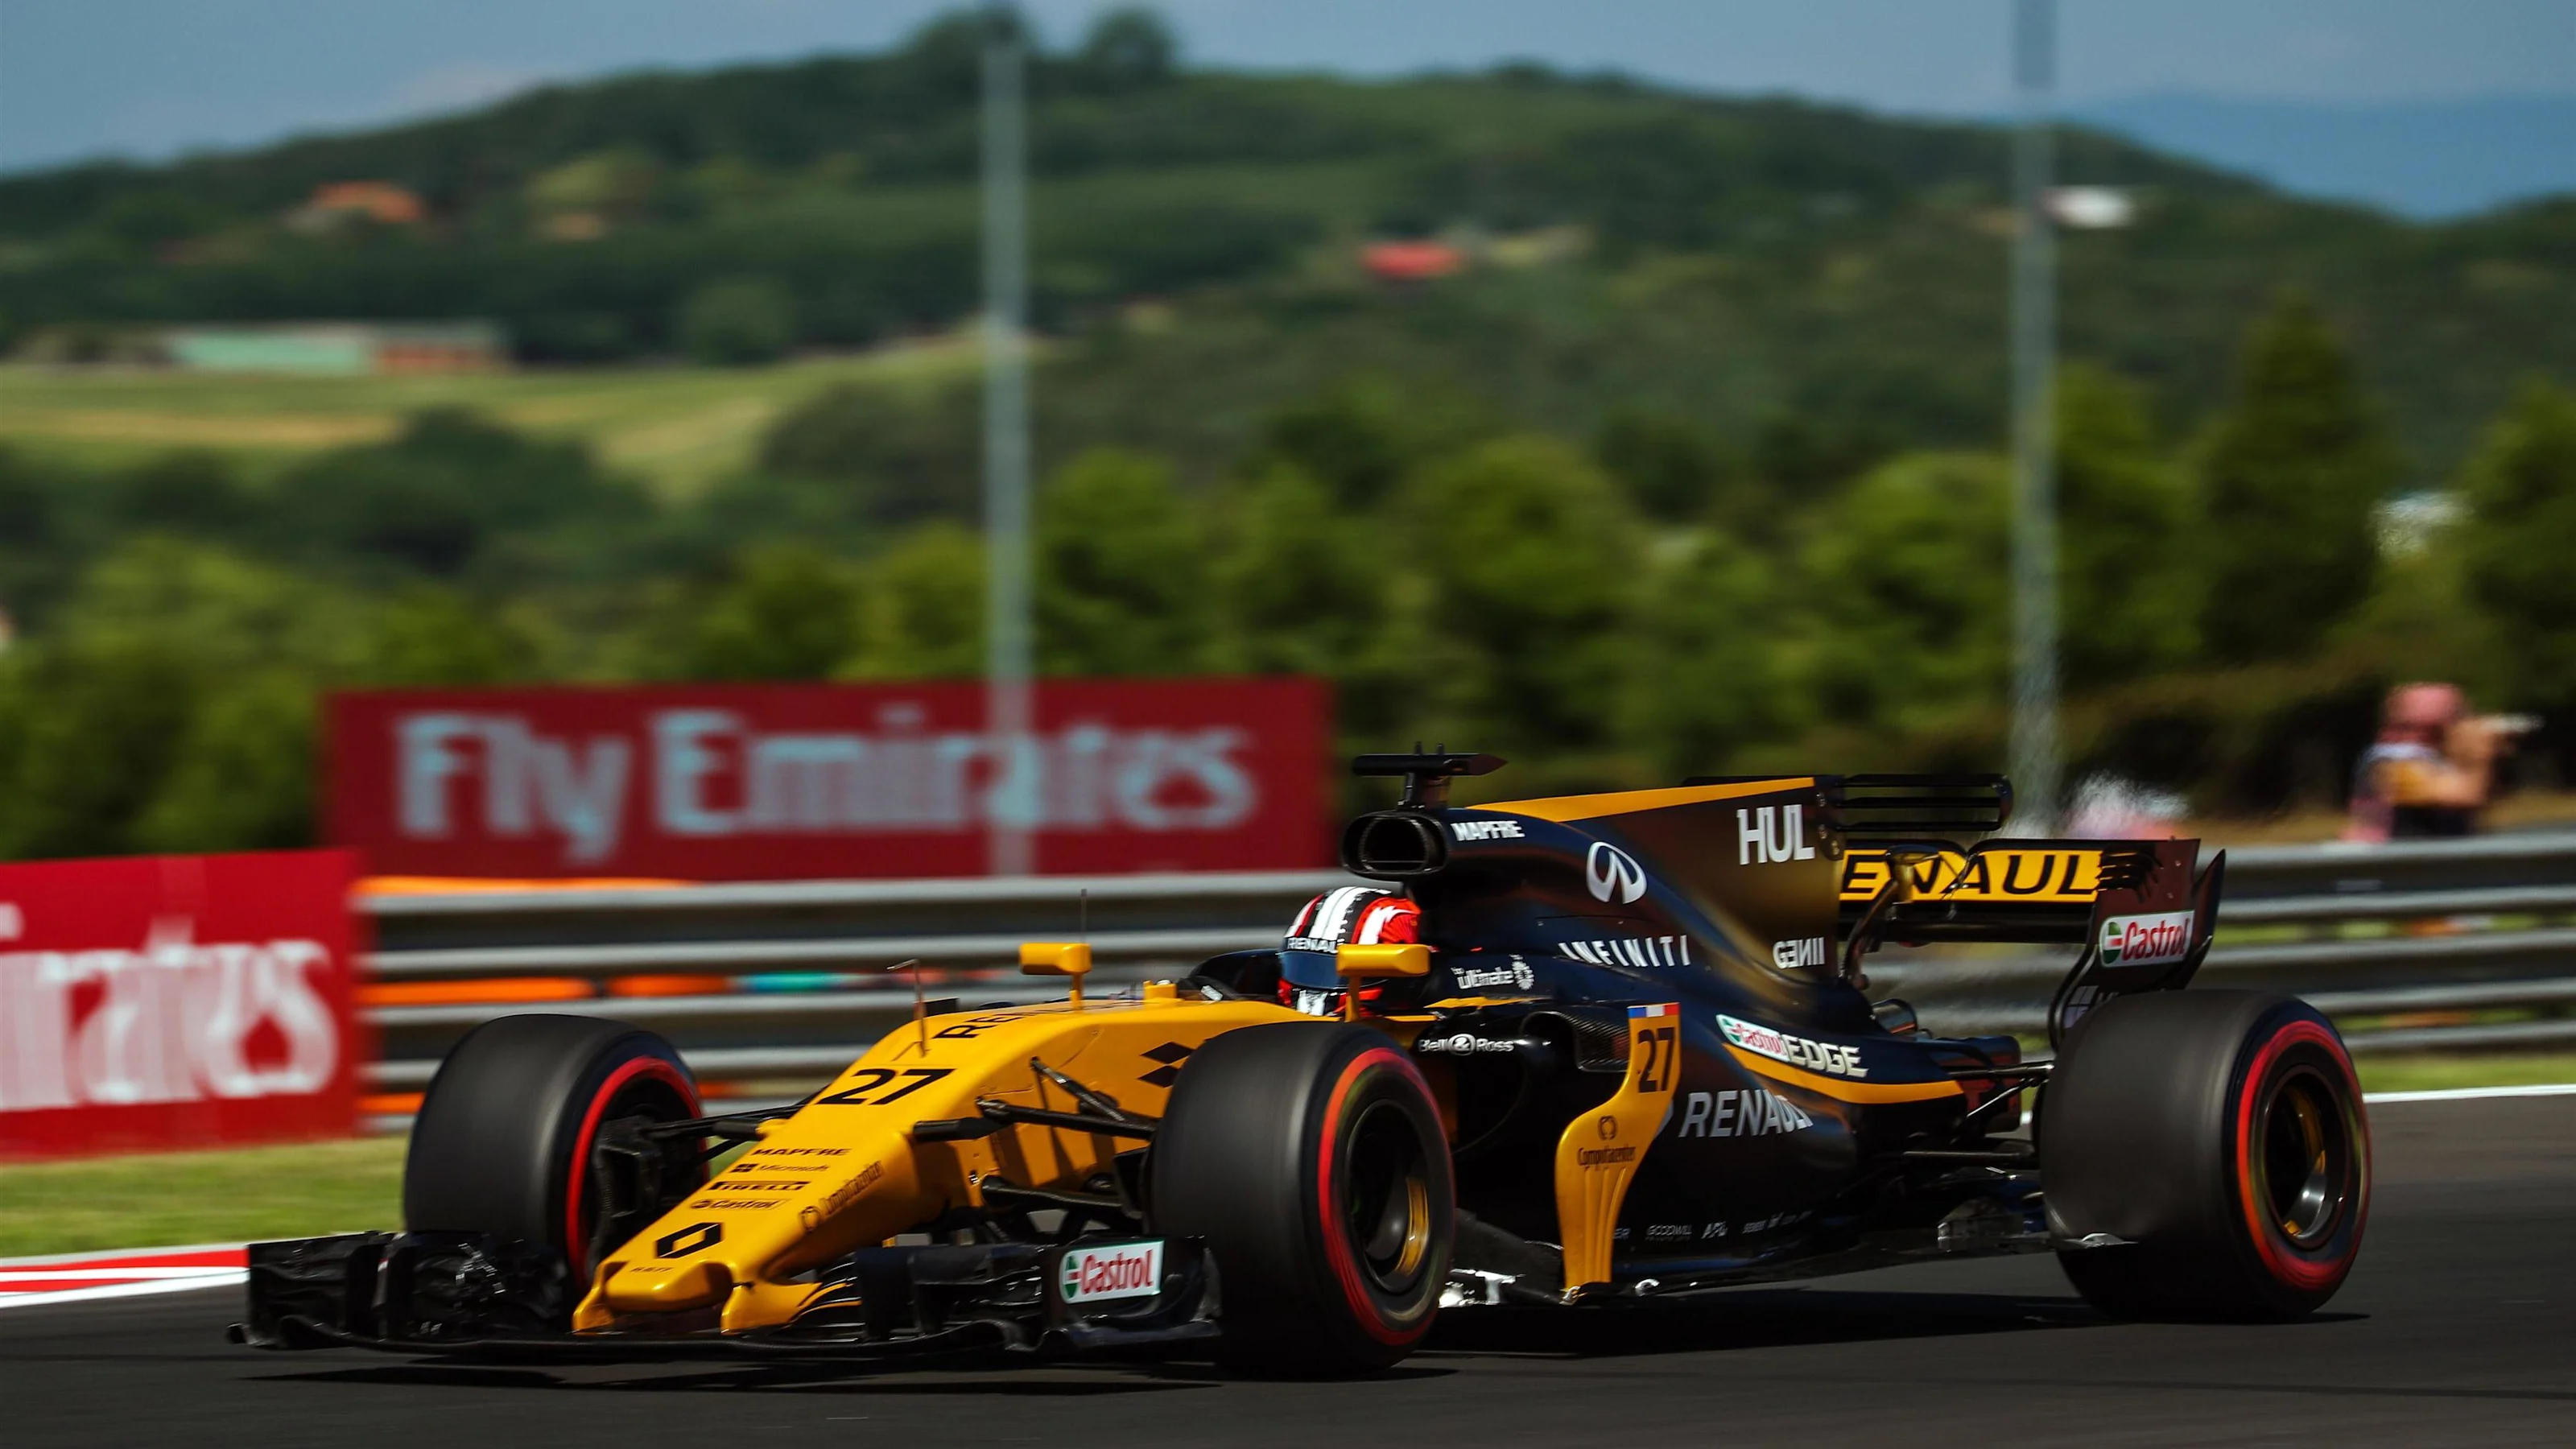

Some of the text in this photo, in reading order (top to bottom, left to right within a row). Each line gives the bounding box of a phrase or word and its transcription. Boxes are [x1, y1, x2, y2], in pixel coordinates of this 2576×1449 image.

[394, 702, 1257, 863] Fly Emirates
[1451, 820, 1525, 841] MAPFRE
[1736, 804, 1815, 865] HUL
[1843, 853, 2095, 895] ENAUL
[1558, 935, 1690, 967] INFINITI
[2122, 917, 2191, 961] Castrol
[1418, 1038, 1448, 1052] Bell
[1476, 1038, 1514, 1052] Ross
[1637, 1027, 1674, 1093] 27
[1781, 1034, 1868, 1077] EDGE
[813, 1068, 956, 1105] 27
[706, 1181, 810, 1190] PIRELLI
[711, 1199, 780, 1208] Castrol
[1080, 1249, 1154, 1294] Castrol
